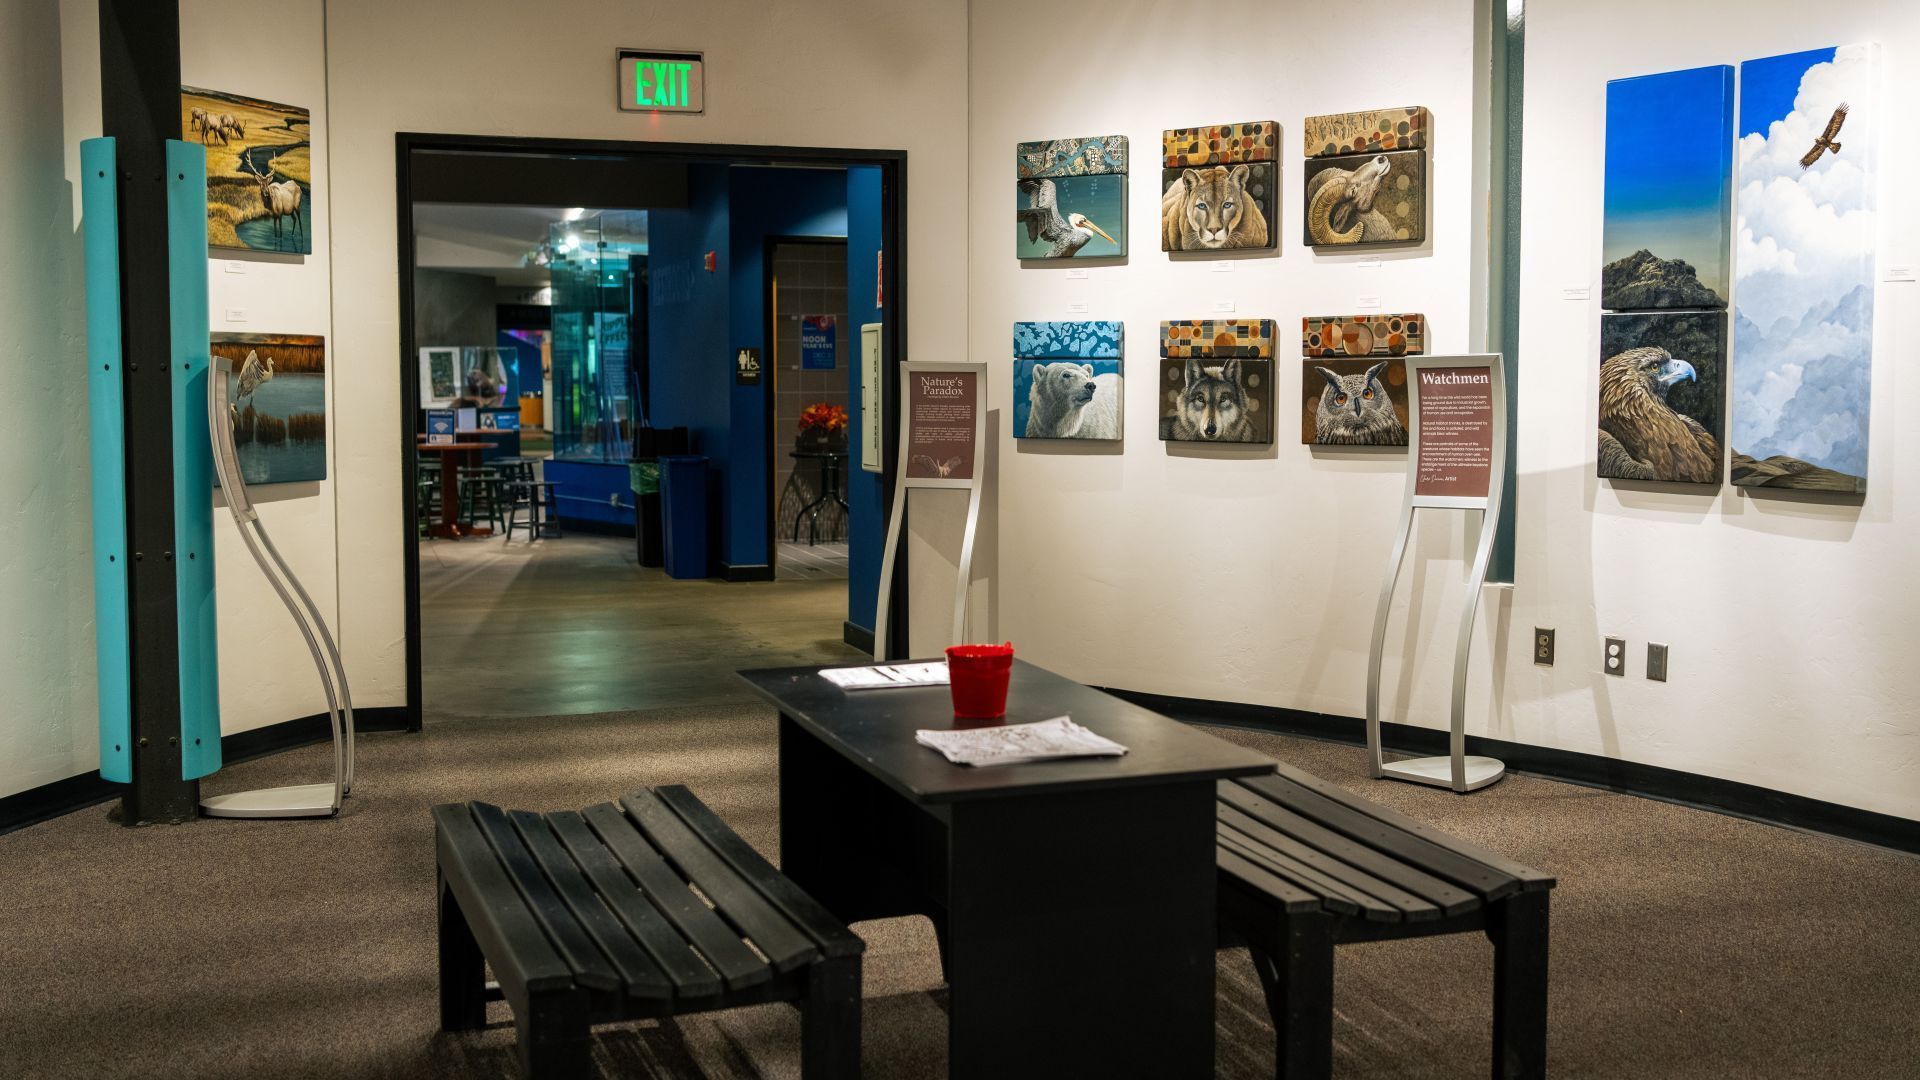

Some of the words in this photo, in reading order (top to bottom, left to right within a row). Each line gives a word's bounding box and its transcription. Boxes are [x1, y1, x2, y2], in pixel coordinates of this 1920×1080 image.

[636, 61, 691, 107] EXIT
[802, 335, 826, 343] NOON
[921, 376, 963, 387] Nature's
[1422, 372, 1488, 385] Watchmen
[923, 386, 964, 396] Paradox
